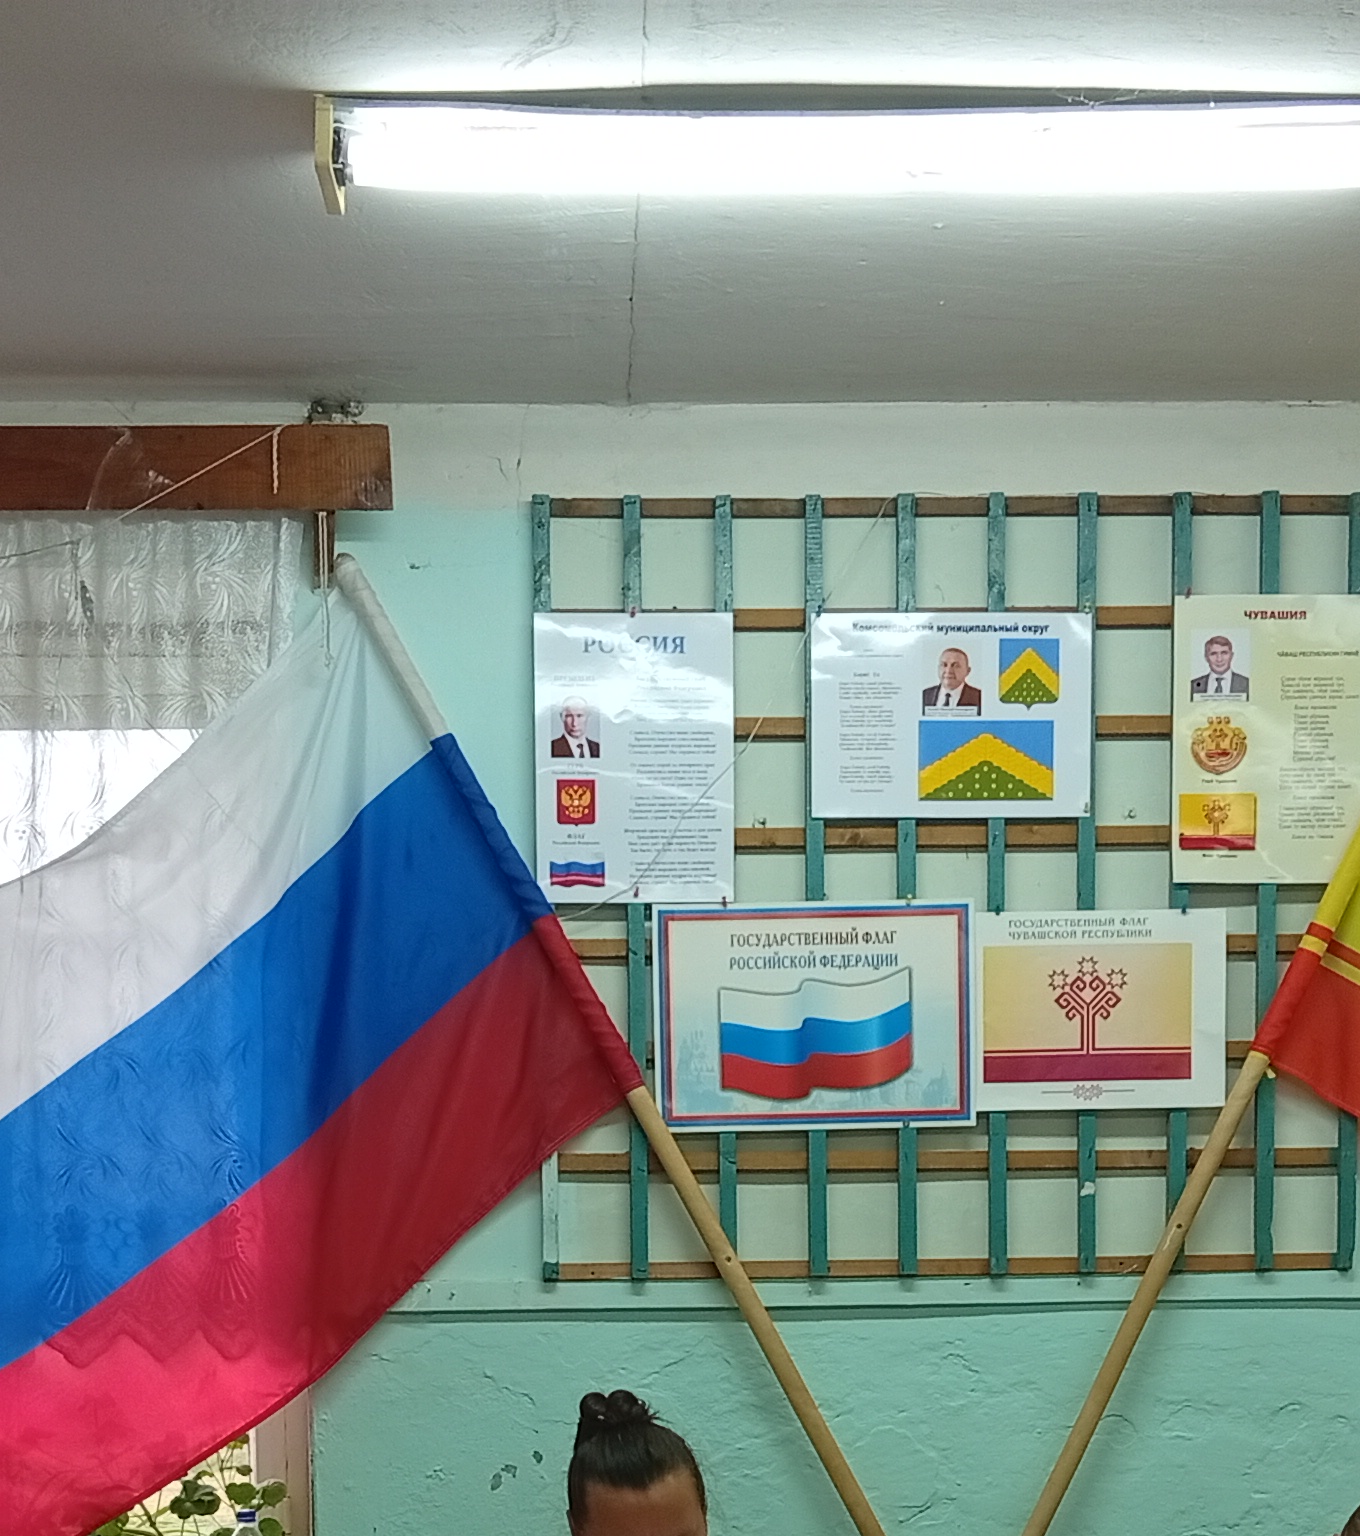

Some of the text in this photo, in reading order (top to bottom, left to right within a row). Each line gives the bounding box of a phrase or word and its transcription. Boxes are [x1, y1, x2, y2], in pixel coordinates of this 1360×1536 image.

[1243, 610, 1307, 621] ЧУВАШИЯ
[936, 622, 1019, 635] муниципальный
[1022, 624, 1050, 635] округ
[582, 635, 686, 654] РОССИЯ
[1008, 917, 1149, 929] ГОСУДАРСТВЕННЫЙ ФЛАГ
[730, 926, 897, 948] ГОСУДАРСТВЕННЫЙ ФЛАГ
[1008, 928, 1152, 940] ЧУВАШСКОЙ РЕСПУБЛИКИ
[729, 951, 899, 970] РОССИЙСКОЙ ФЕДЕРАЦИИ
